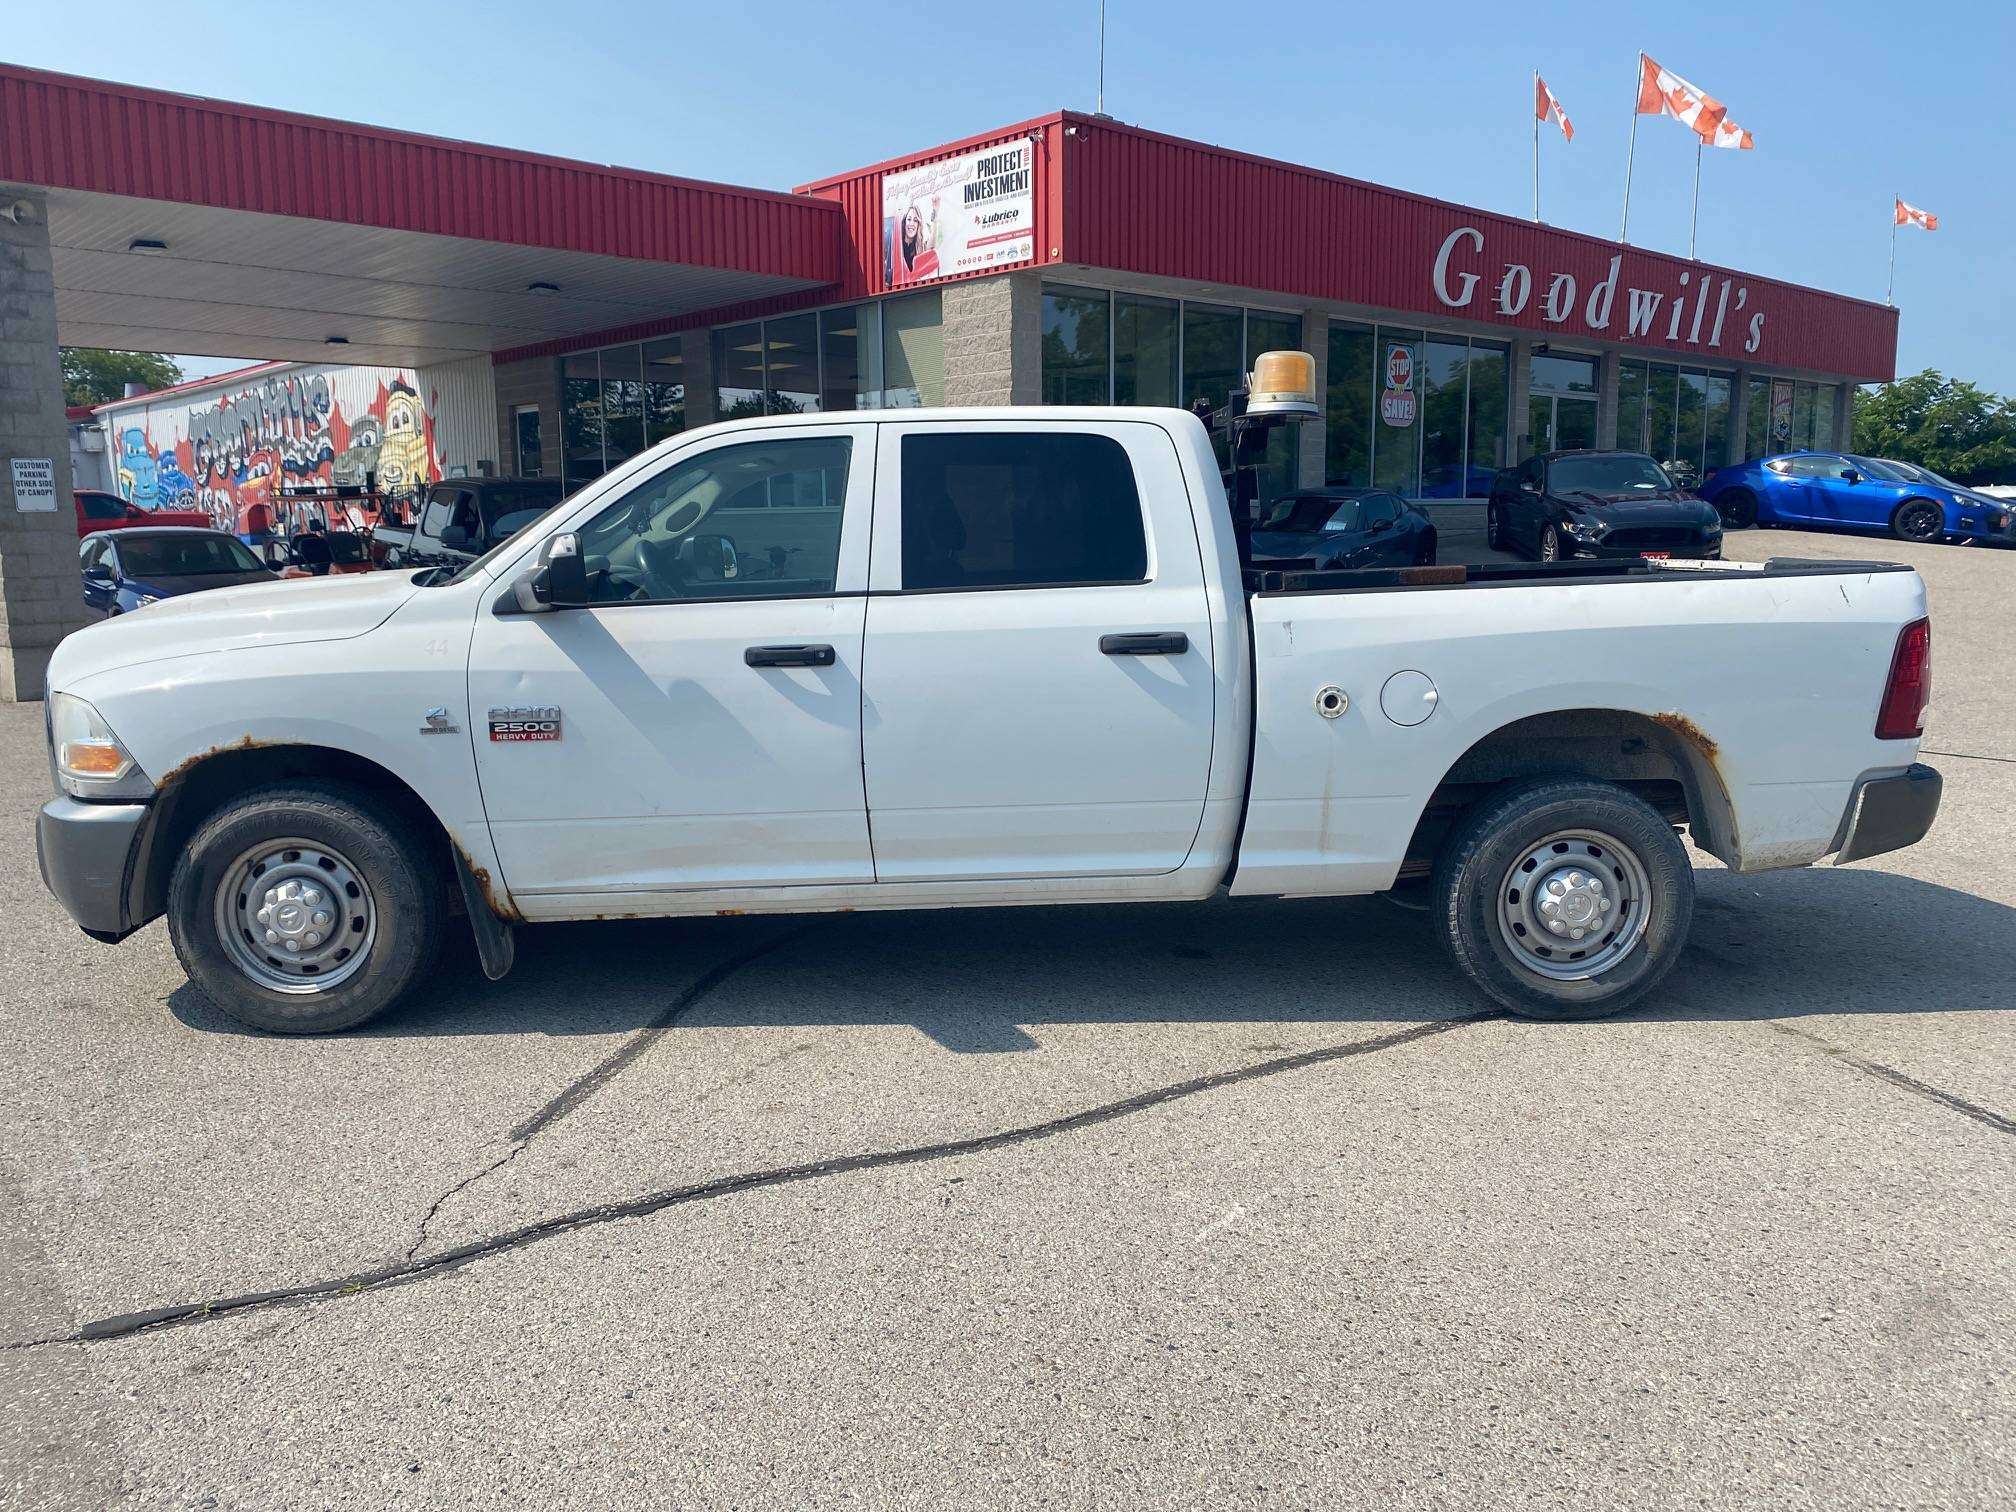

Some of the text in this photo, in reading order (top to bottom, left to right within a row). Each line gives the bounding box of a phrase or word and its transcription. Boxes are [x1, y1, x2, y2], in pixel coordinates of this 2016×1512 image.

[977, 148, 1023, 179] PROTECT
[964, 169, 1030, 203] INVESTMENT
[982, 209, 1019, 224] Lubrico
[1433, 227, 1765, 353] Goodwill's
[1390, 358, 1410, 376] STOP
[1385, 398, 1414, 420] SAVE!
[488, 705, 560, 720] RAM
[494, 723, 556, 732] 2500
